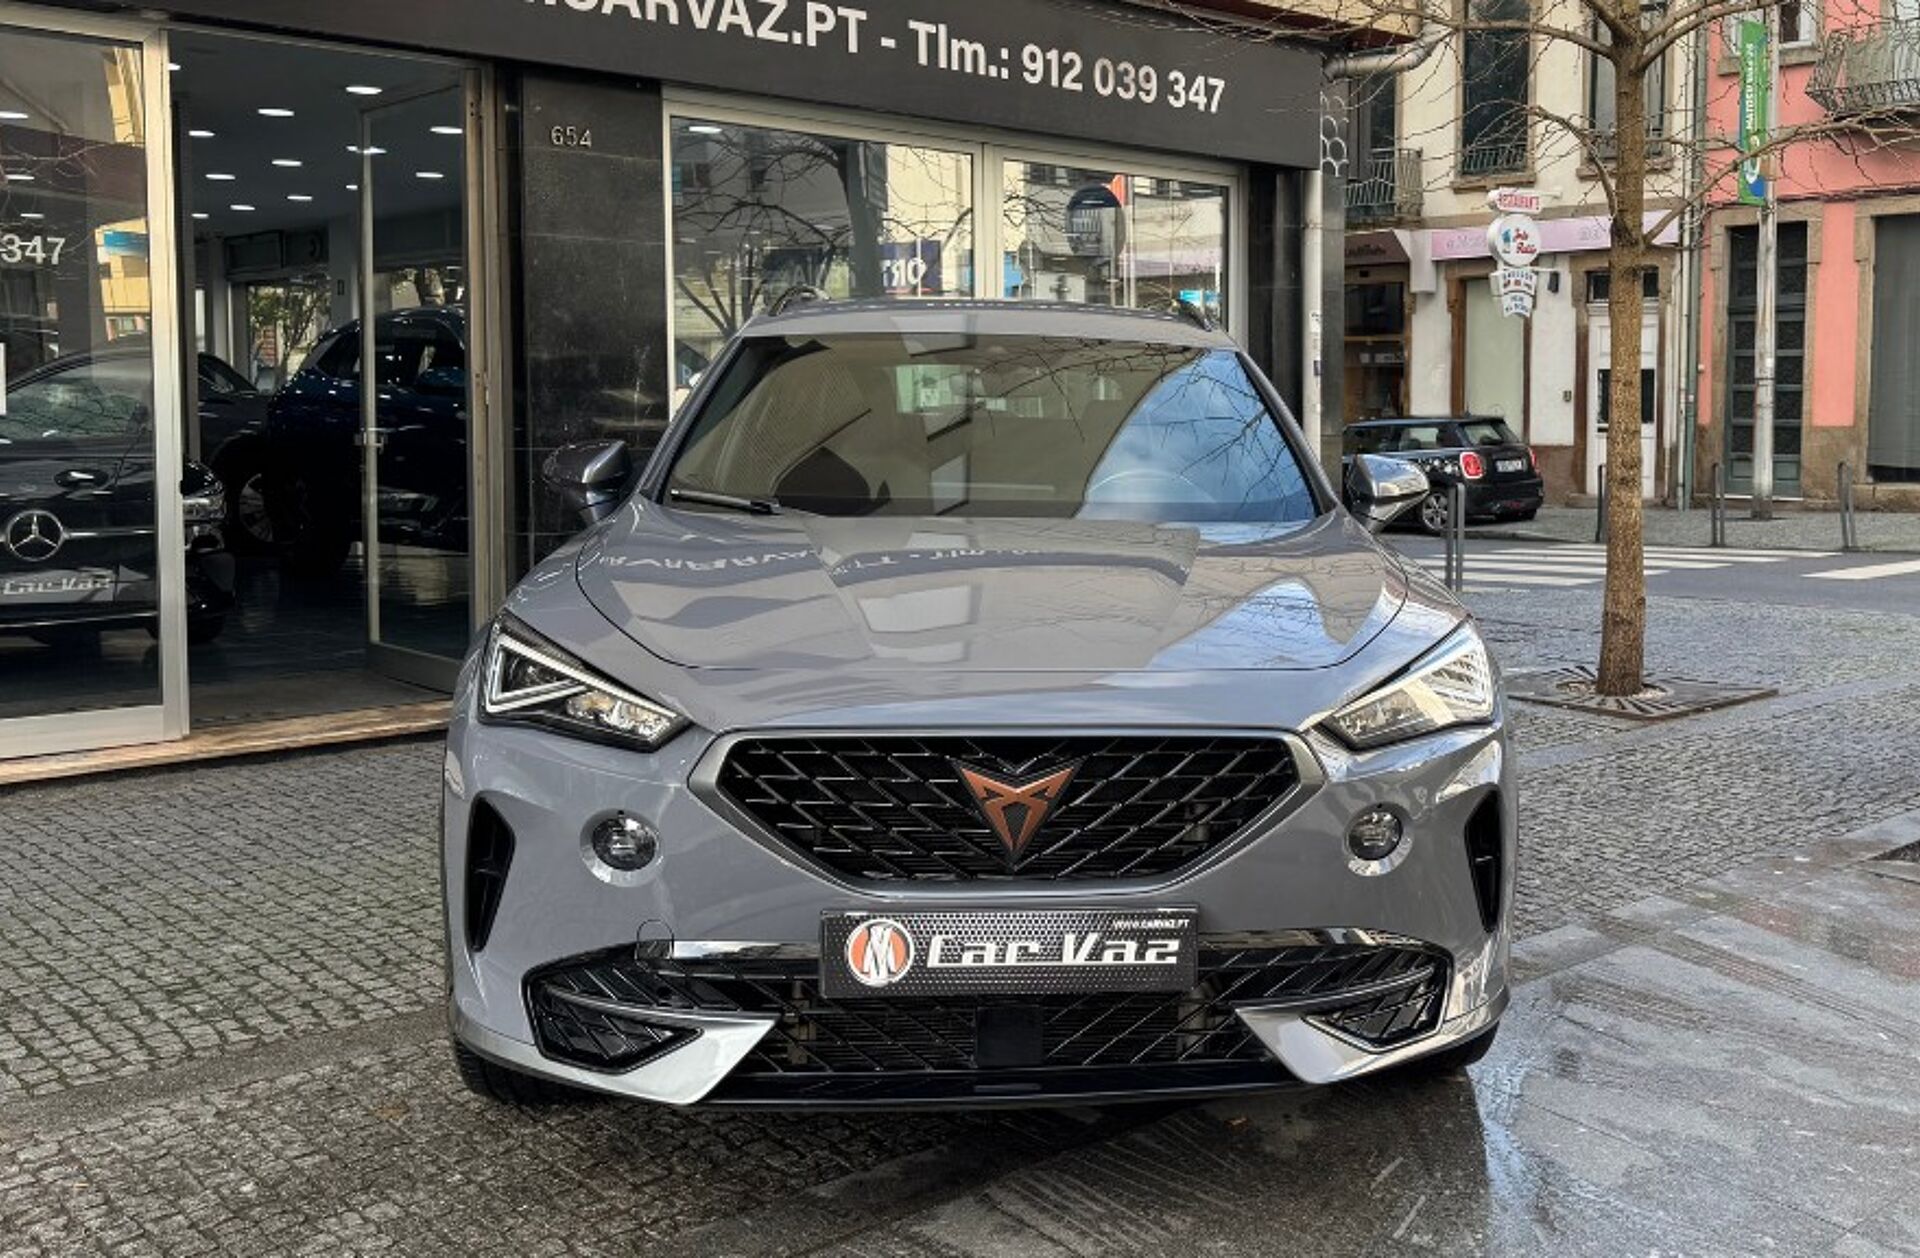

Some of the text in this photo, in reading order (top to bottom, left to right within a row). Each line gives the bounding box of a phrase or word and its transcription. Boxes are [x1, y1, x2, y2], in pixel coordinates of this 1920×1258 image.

[908, 19, 1009, 79] Tlm.:
[1021, 43, 1083, 92] 912
[1094, 57, 1157, 104] 039
[1167, 70, 1225, 114] 347
[551, 126, 592, 147] 654
[0, 233, 66, 264] 347
[927, 935, 1040, 967] Car
[1062, 932, 1180, 965] Vaz
